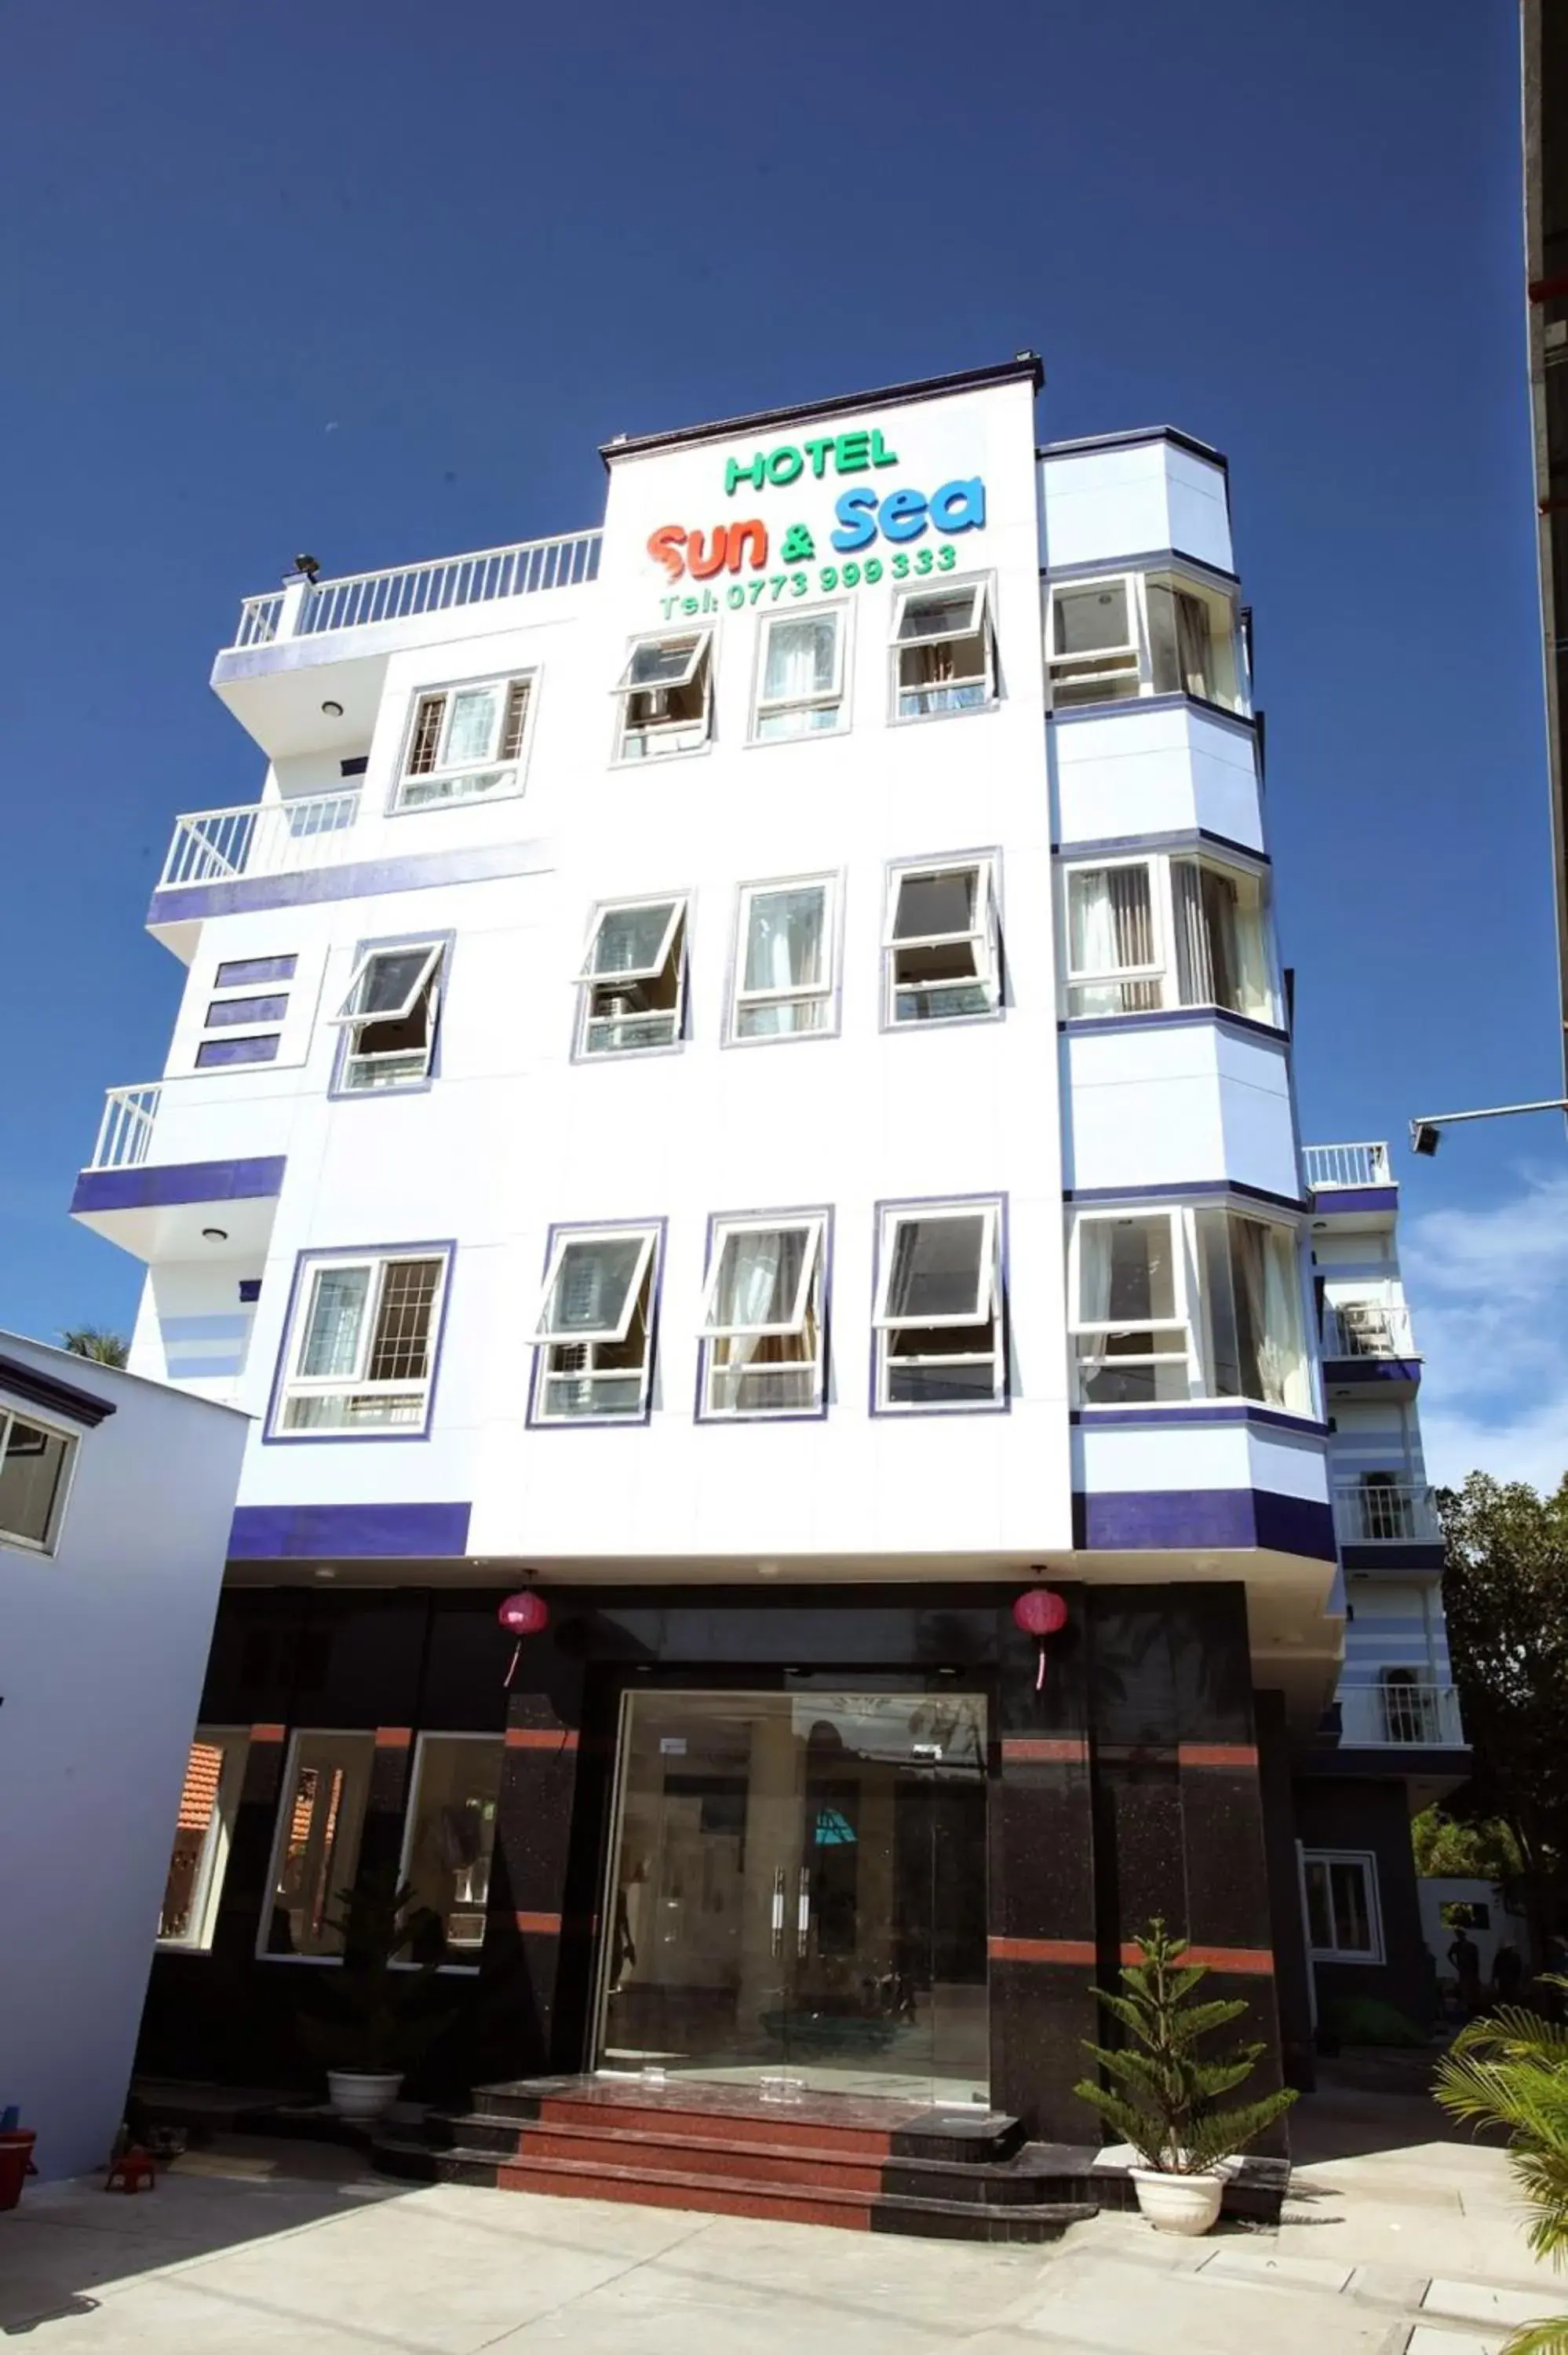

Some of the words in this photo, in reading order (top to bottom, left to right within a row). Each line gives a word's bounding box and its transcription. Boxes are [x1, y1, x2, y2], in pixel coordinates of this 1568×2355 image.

[724, 429, 897, 495] HOTEL
[647, 518, 768, 584] Sun
[780, 523, 815, 564] &
[830, 476, 986, 553] Sea
[660, 589, 718, 620] Tel:
[727, 571, 808, 610] 0773
[820, 558, 884, 593] 999
[892, 545, 957, 578] 333
